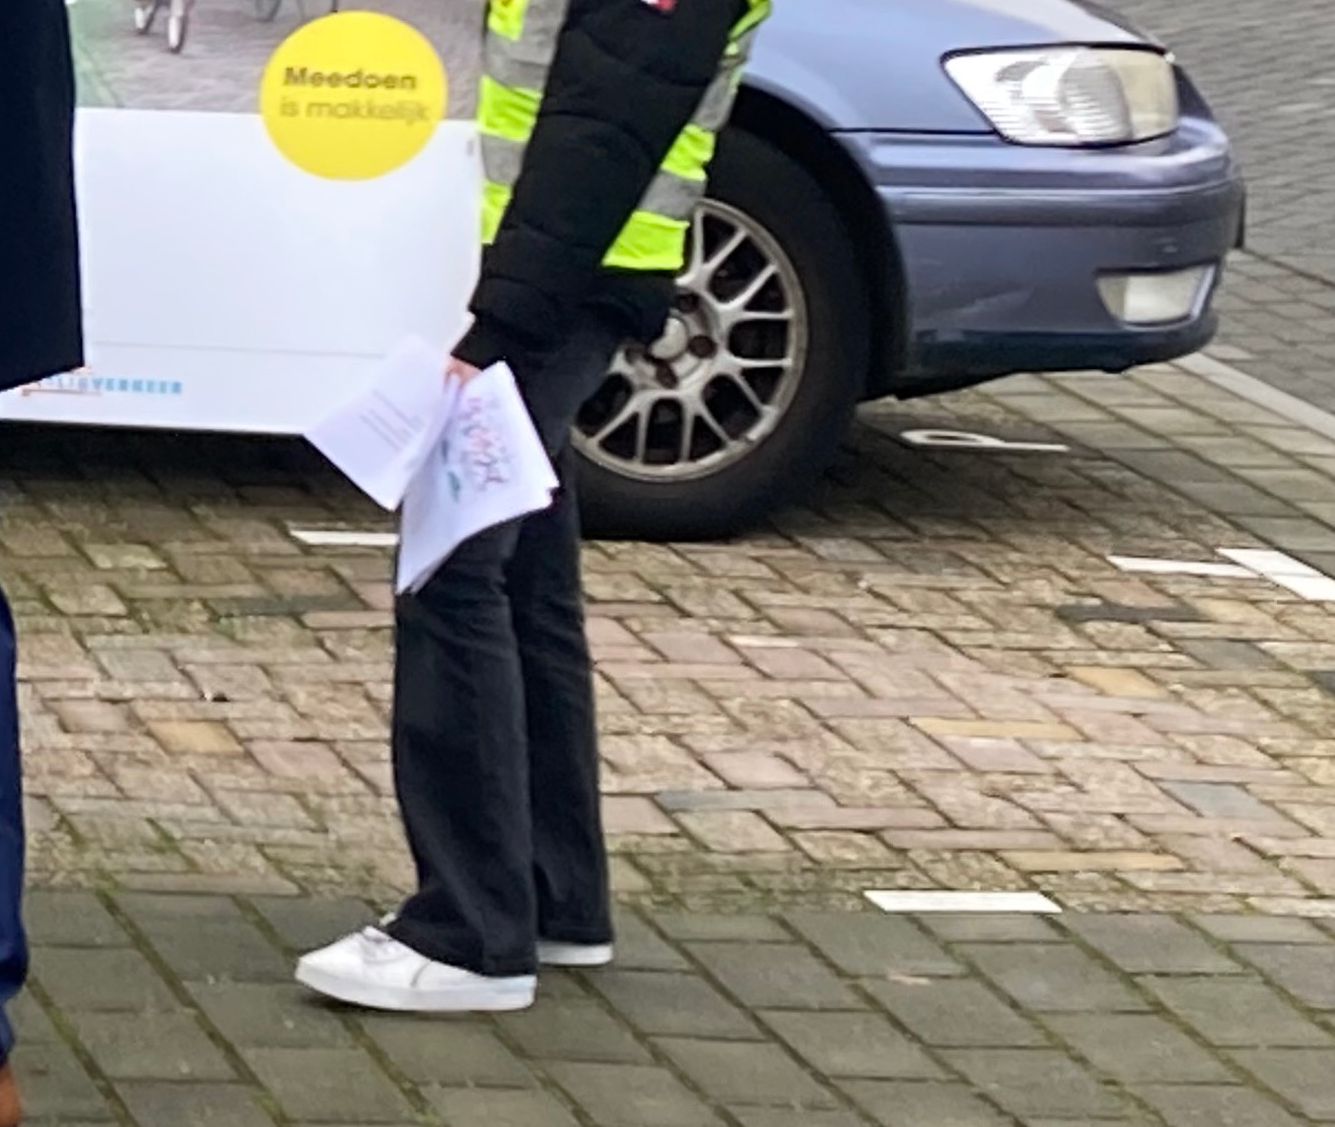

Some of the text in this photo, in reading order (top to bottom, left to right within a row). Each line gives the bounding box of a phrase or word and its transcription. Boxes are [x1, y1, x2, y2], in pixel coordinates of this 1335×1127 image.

[283, 67, 417, 90] Meedoen
[280, 97, 429, 127] is makkelijk
